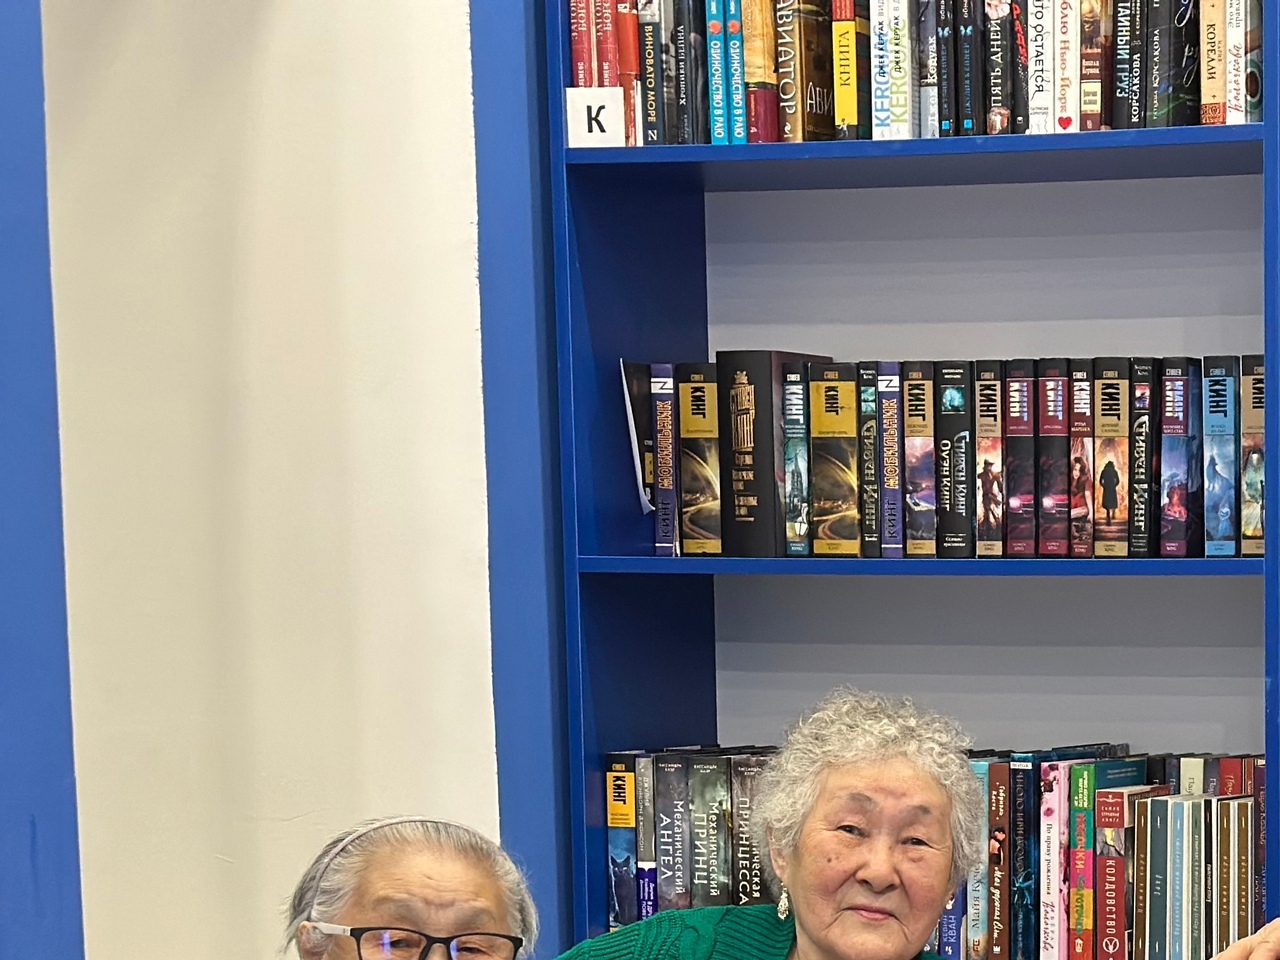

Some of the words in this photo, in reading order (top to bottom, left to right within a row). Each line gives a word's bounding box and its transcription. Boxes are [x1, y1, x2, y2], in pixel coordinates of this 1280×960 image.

[644, 25, 655, 89] ВИНОВАТО
[839, 31, 851, 87] КНИГА
[986, 18, 1003, 63] ДНЕЙ
[1206, 21, 1218, 80] КОРЕЛЛИ
[711, 40, 723, 106] ОДИНОЧЕСТВО
[730, 40, 742, 106] ОДИНОЧЕСТВО
[989, 66, 1003, 107] ПЯТЬ
[1130, 51, 1141, 123] КОРСАКОВА
[586, 104, 607, 134] К
[646, 91, 657, 123] МОРЕ
[690, 385, 707, 419] КИНГ
[785, 384, 805, 425] КИНГ
[824, 385, 840, 416] КИНГ
[907, 382, 927, 422] КИНГ
[978, 383, 999, 423] КИНГ
[1072, 380, 1092, 418] КИНГ
[1100, 381, 1121, 422] КИНГ
[1207, 377, 1228, 419] КИНГ
[612, 775, 627, 806] КИНГ
[659, 813, 674, 880] АНГЕЛ
[673, 800, 686, 895] Механический
[693, 813, 708, 885] ПРИНЦ
[708, 802, 720, 896] Механический
[737, 797, 750, 906] ПРИНЦЕССА
[1105, 858, 1116, 934] КОЛДОВСТВО
[948, 914, 956, 943] КВАН
